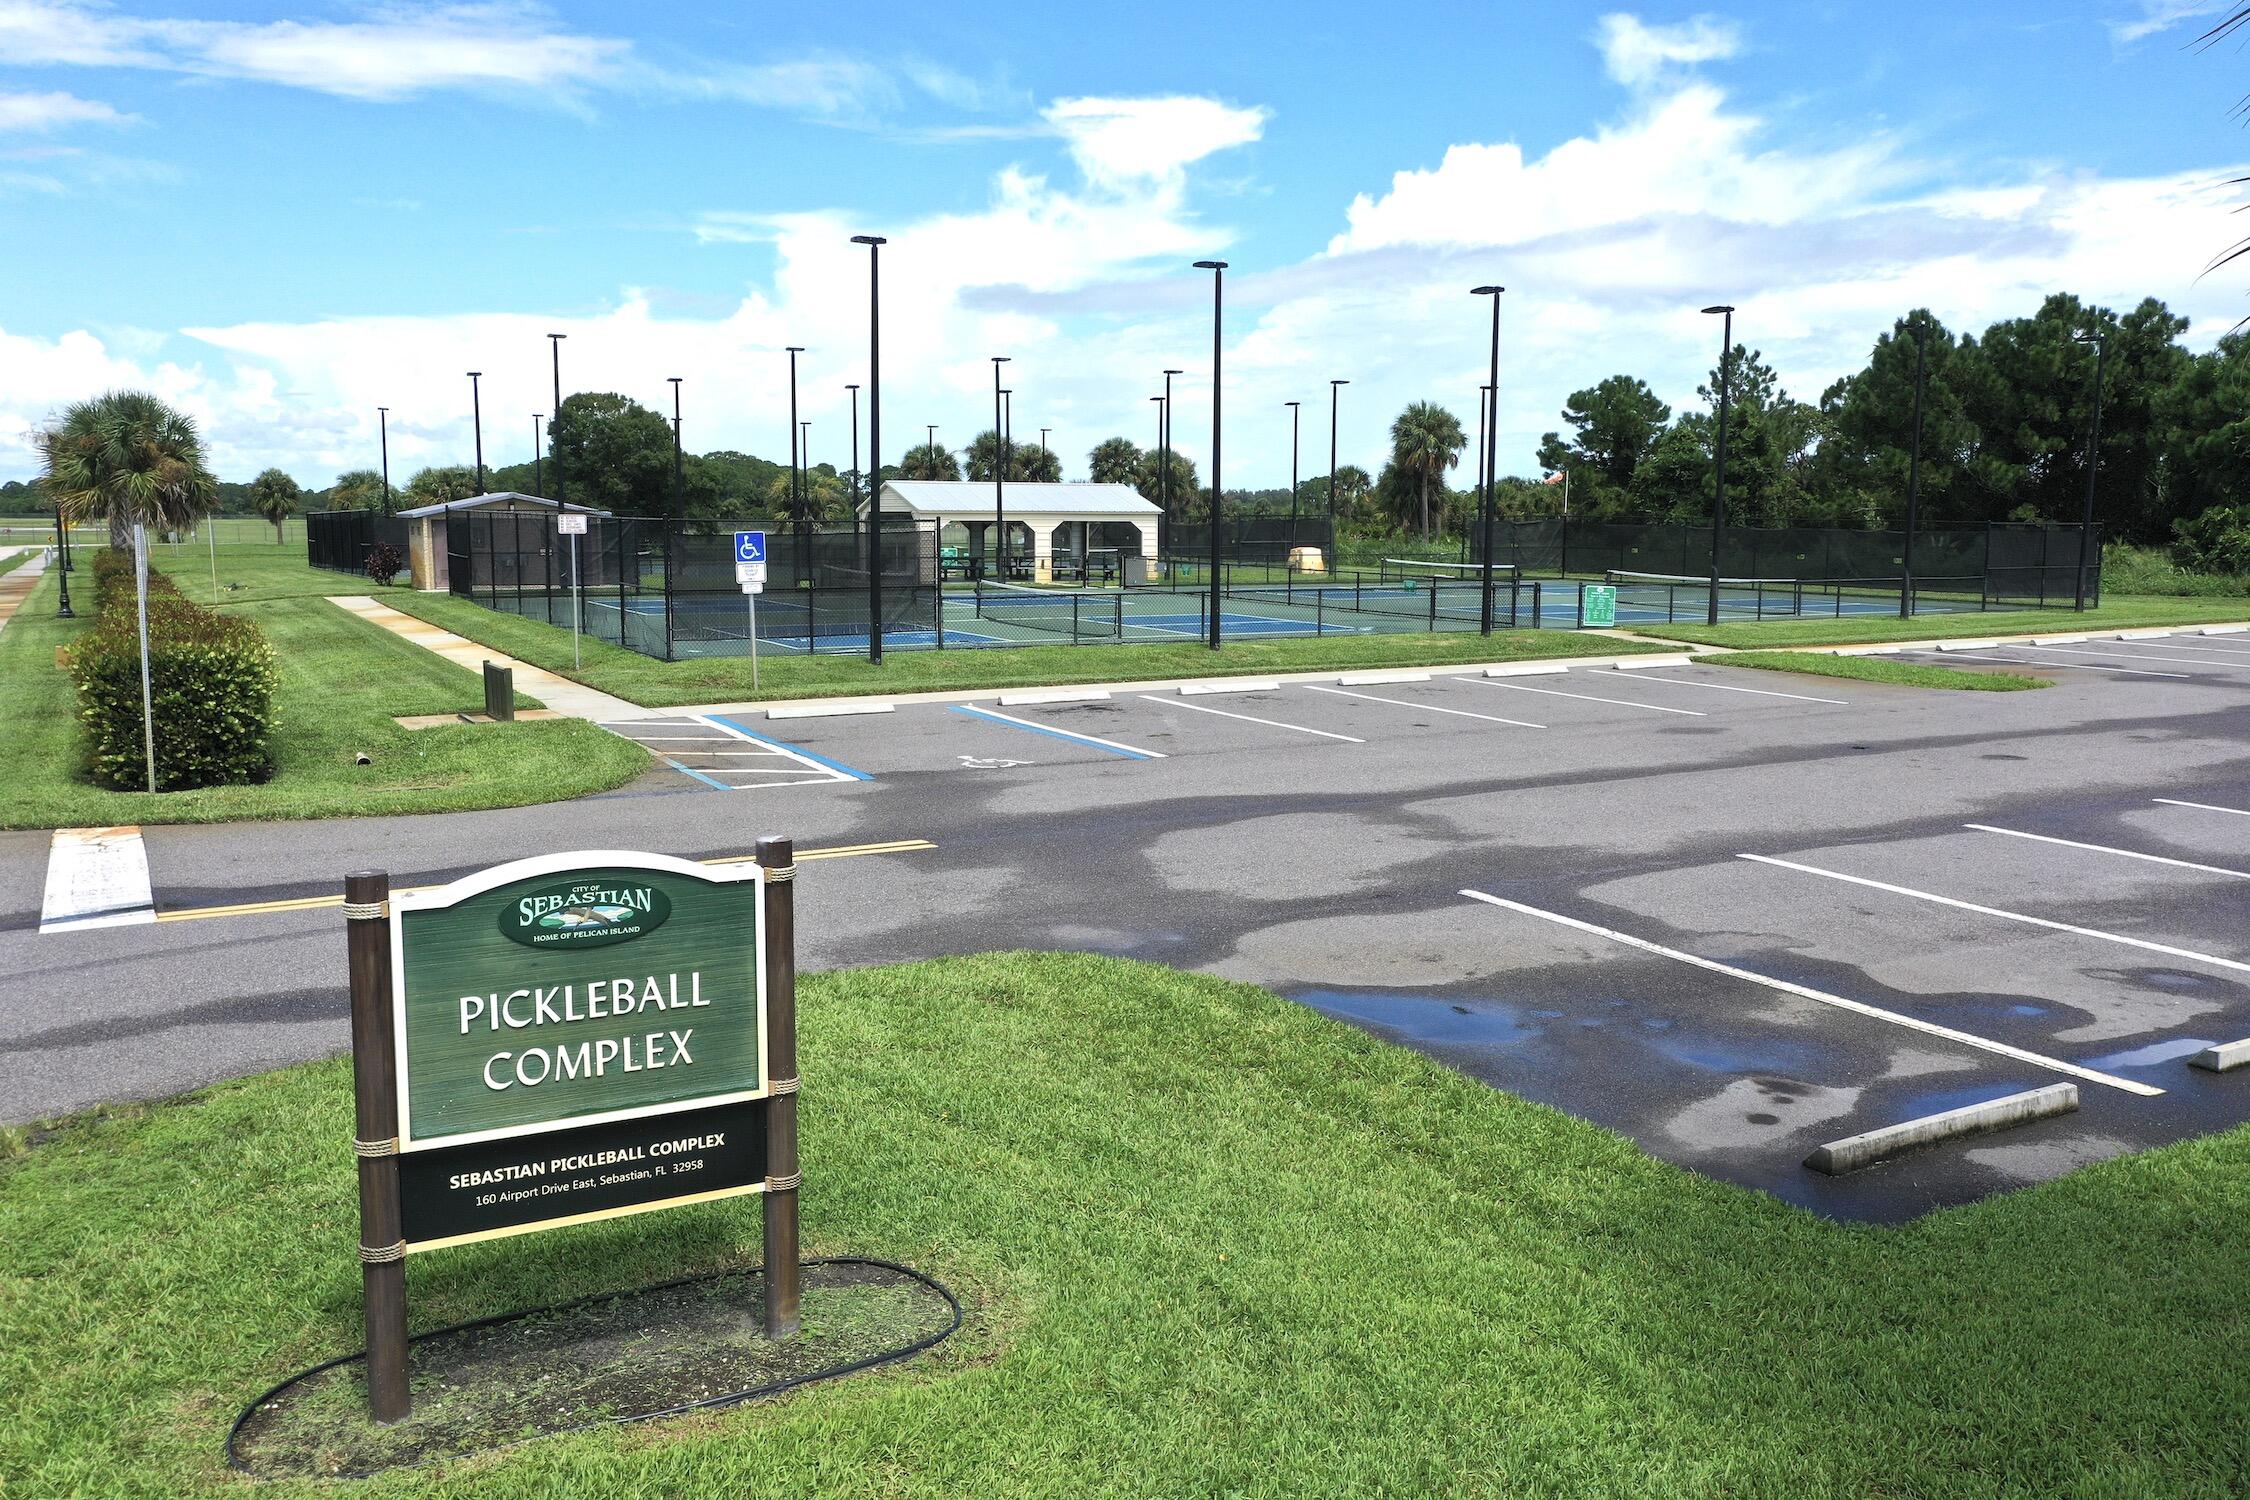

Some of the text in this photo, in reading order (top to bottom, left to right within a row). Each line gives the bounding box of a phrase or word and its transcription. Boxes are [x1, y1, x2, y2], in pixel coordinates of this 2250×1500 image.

[519, 888, 652, 927] SEBASTIAN
[572, 885, 589, 893] CITY
[533, 926, 640, 942] HOME OF PELICAN ISLAND
[459, 971, 711, 1035] PICKLEBALL
[483, 1028, 693, 1091] COMPLEX
[449, 1132, 726, 1190] SEBASTIAN PICKLEBALL COMPLEX
[475, 1159, 704, 1207] 160 Airport Drive East, Sebastian, FL 32958
